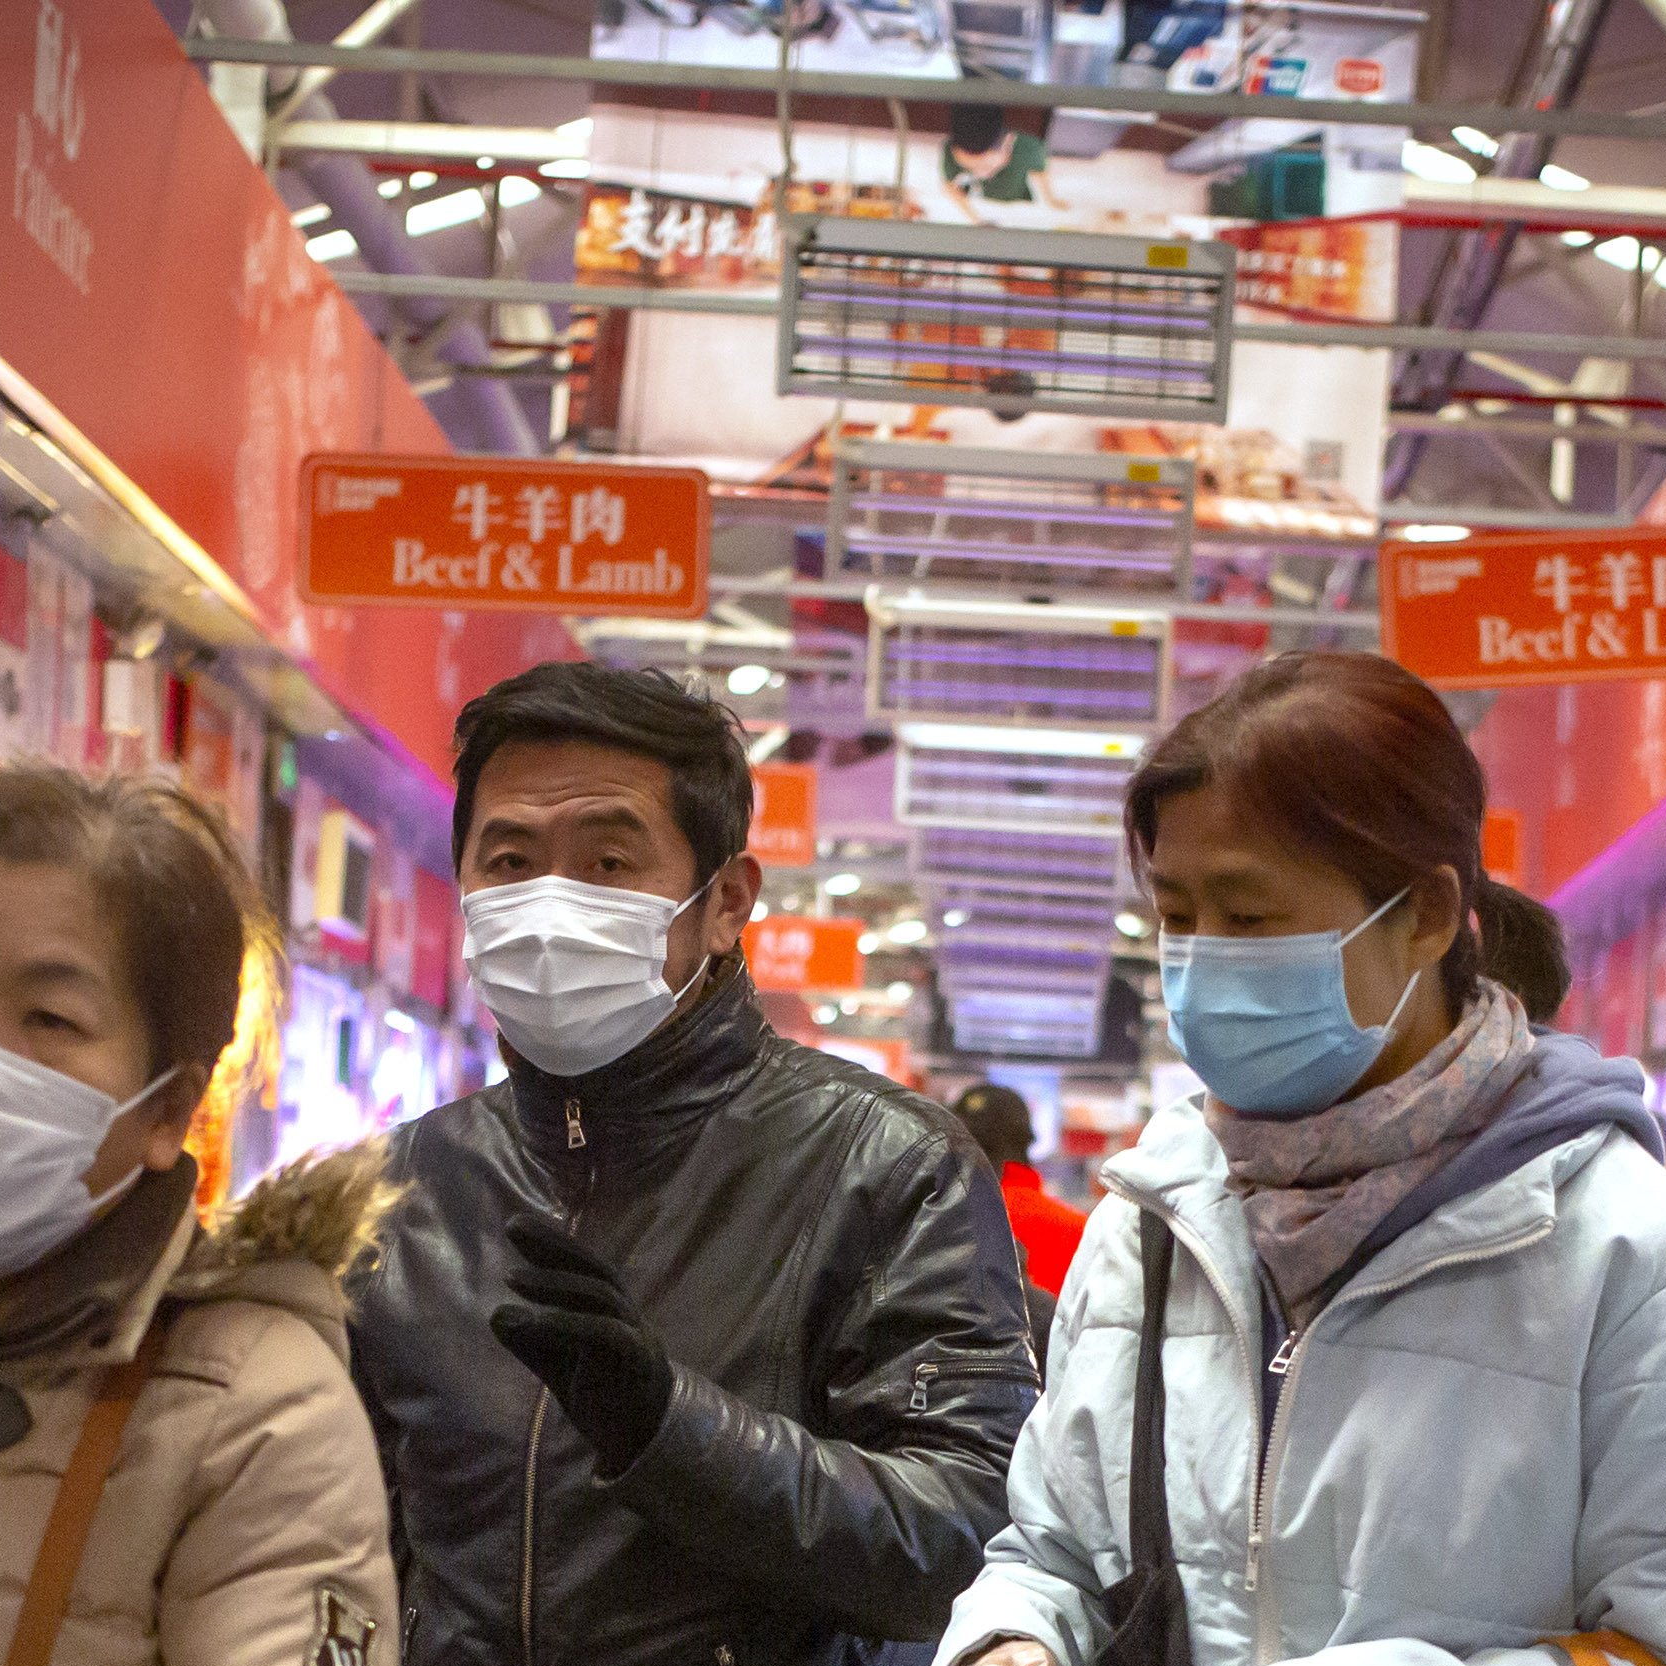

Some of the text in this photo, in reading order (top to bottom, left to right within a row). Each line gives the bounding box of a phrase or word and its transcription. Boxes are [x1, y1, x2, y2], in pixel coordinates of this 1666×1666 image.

[451, 481, 626, 545] 牛羊肉
[393, 538, 685, 595] Beef & Lamb
[1478, 610, 1584, 664] Beef
[1587, 610, 1629, 660] &
